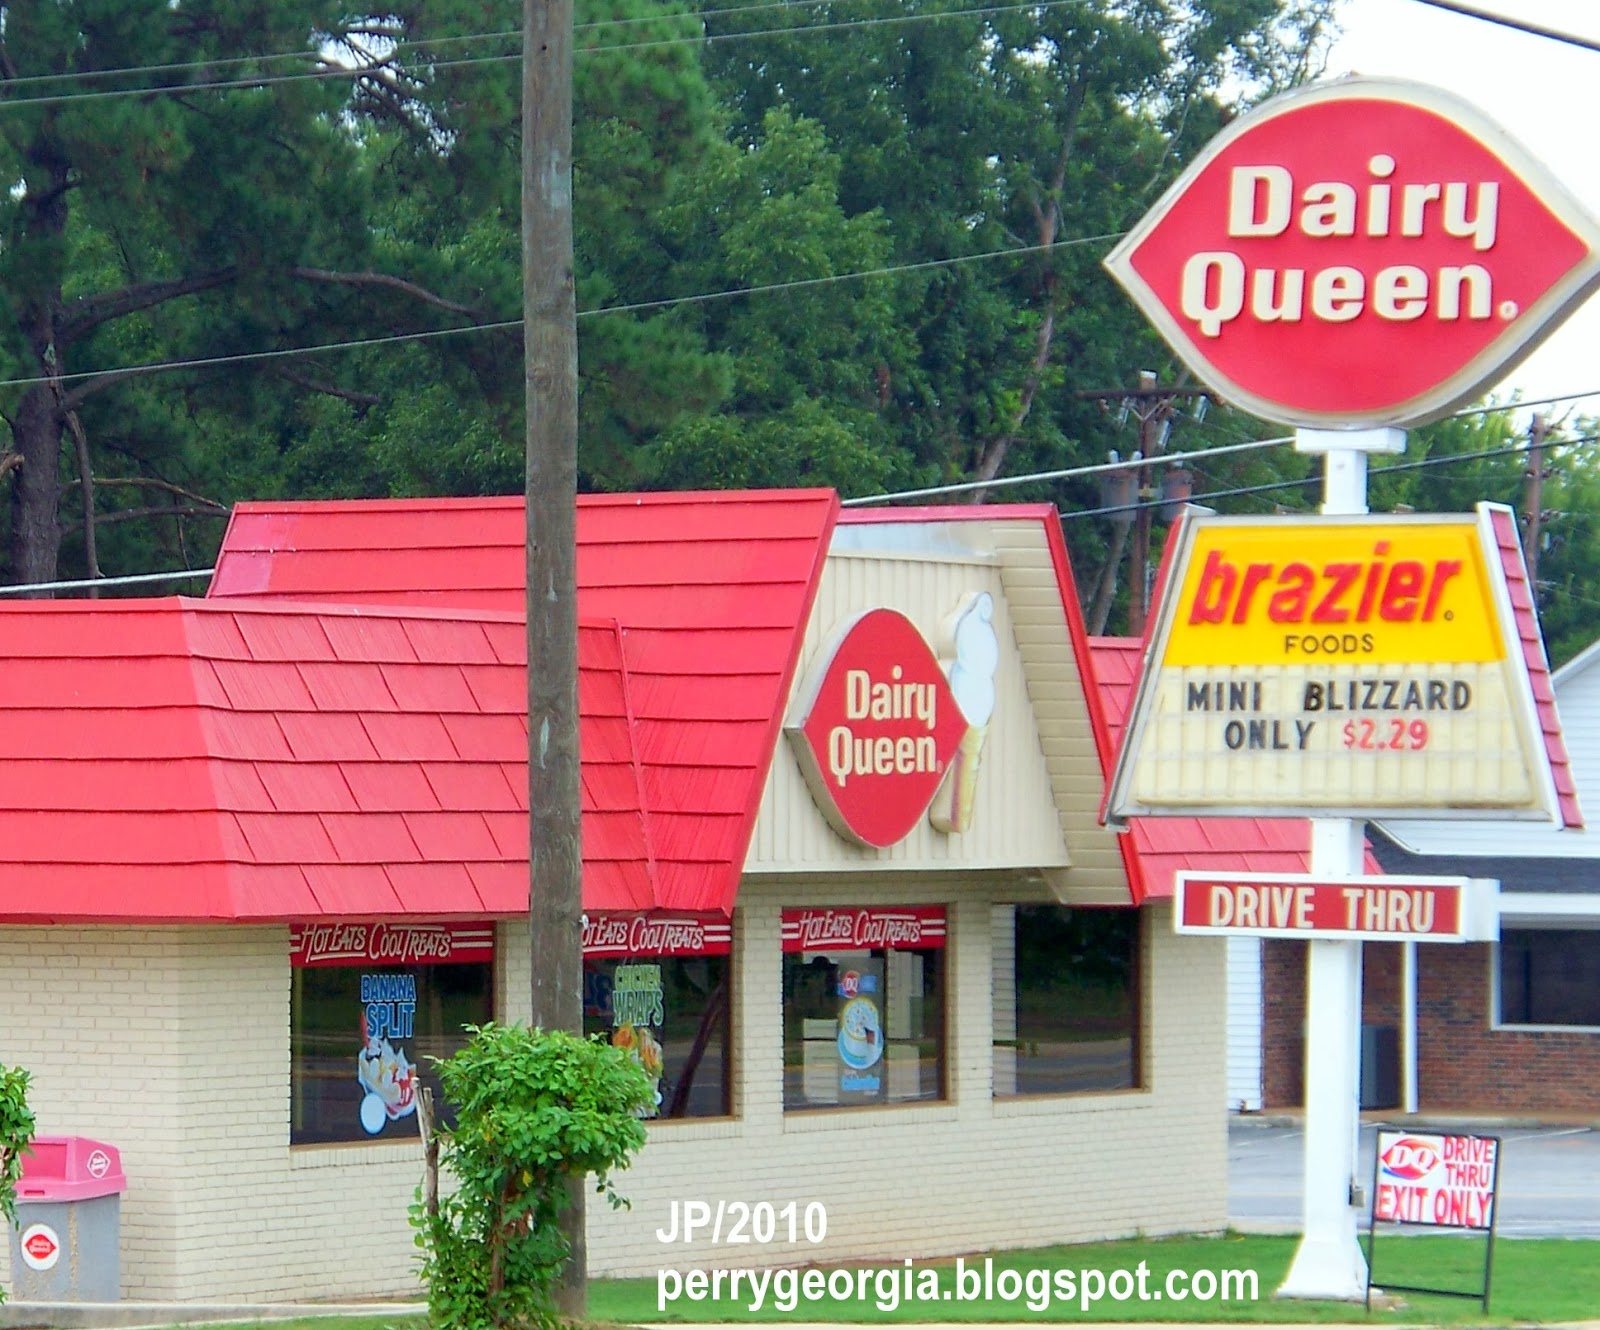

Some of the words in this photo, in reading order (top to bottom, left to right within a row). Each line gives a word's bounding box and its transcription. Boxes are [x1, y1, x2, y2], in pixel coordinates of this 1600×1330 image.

[1228, 154, 1500, 251] Dairy
[1181, 251, 1493, 338] Queen
[1187, 541, 1464, 626] brazier
[1284, 633, 1376, 655] FOODS
[846, 665, 937, 730] Dairy
[1186, 680, 1263, 713] MINI
[1303, 680, 1473, 713] BLIZZARD
[1223, 719, 1316, 752] ONLY
[1342, 719, 1430, 752] $2.29
[829, 725, 937, 788] Queen
[1209, 886, 1316, 930] DRIVE
[1342, 888, 1435, 934] THRU
[361, 974, 416, 1002] BANANA
[365, 1003, 415, 1038] SPLIT
[612, 988, 664, 1027] WRAPS
[1390, 1145, 1437, 1172] DQ
[1443, 1135, 1494, 1163] DRIVE
[1445, 1163, 1490, 1188] THRU
[1376, 1184, 1429, 1221] EXIT
[1434, 1188, 1494, 1228] ONLY
